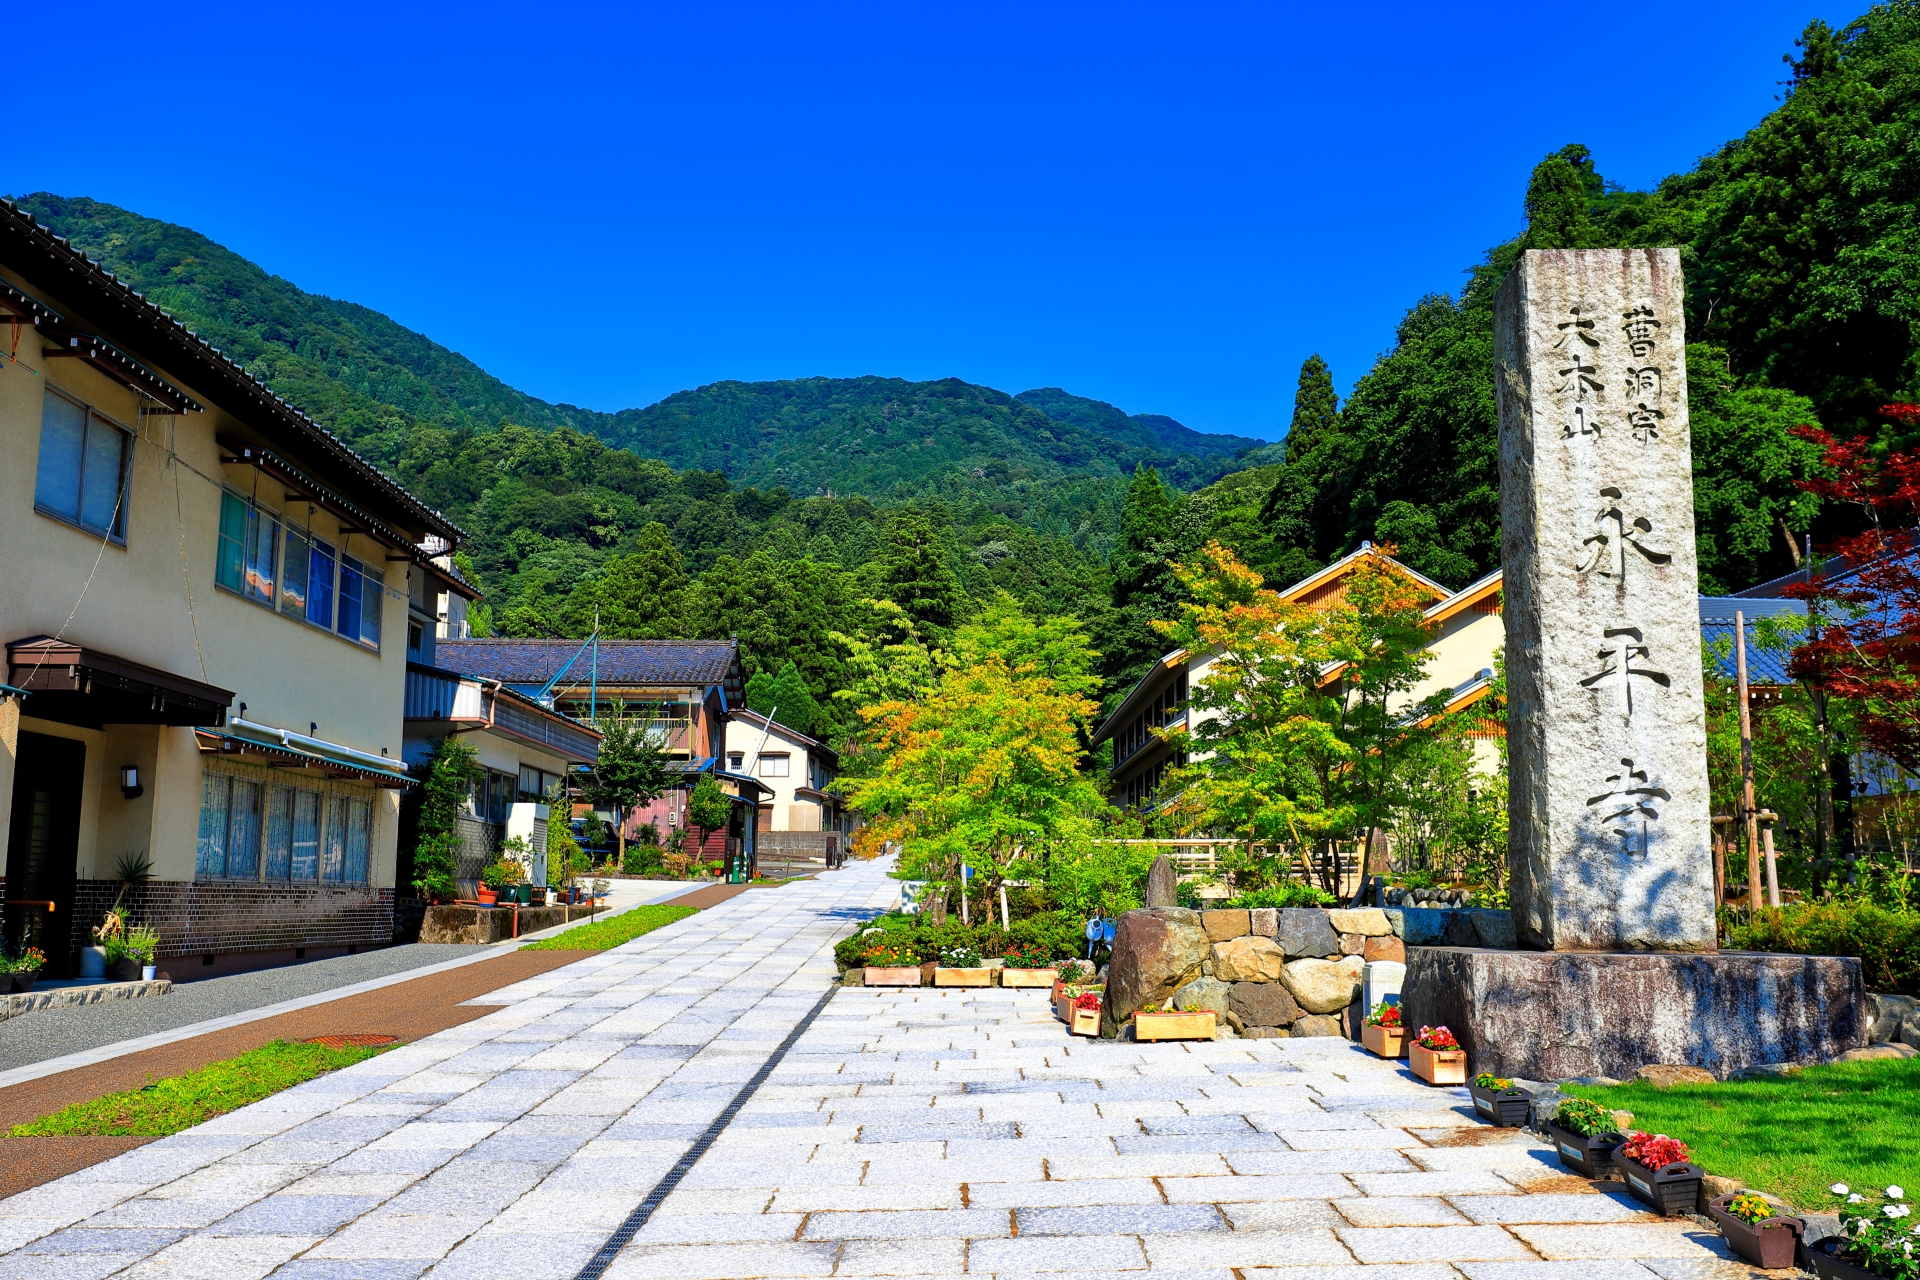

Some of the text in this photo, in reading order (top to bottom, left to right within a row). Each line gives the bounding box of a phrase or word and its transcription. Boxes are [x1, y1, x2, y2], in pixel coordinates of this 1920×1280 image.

[1553, 306, 1605, 443] 大本山
[1575, 486, 1672, 859] 永平寺
